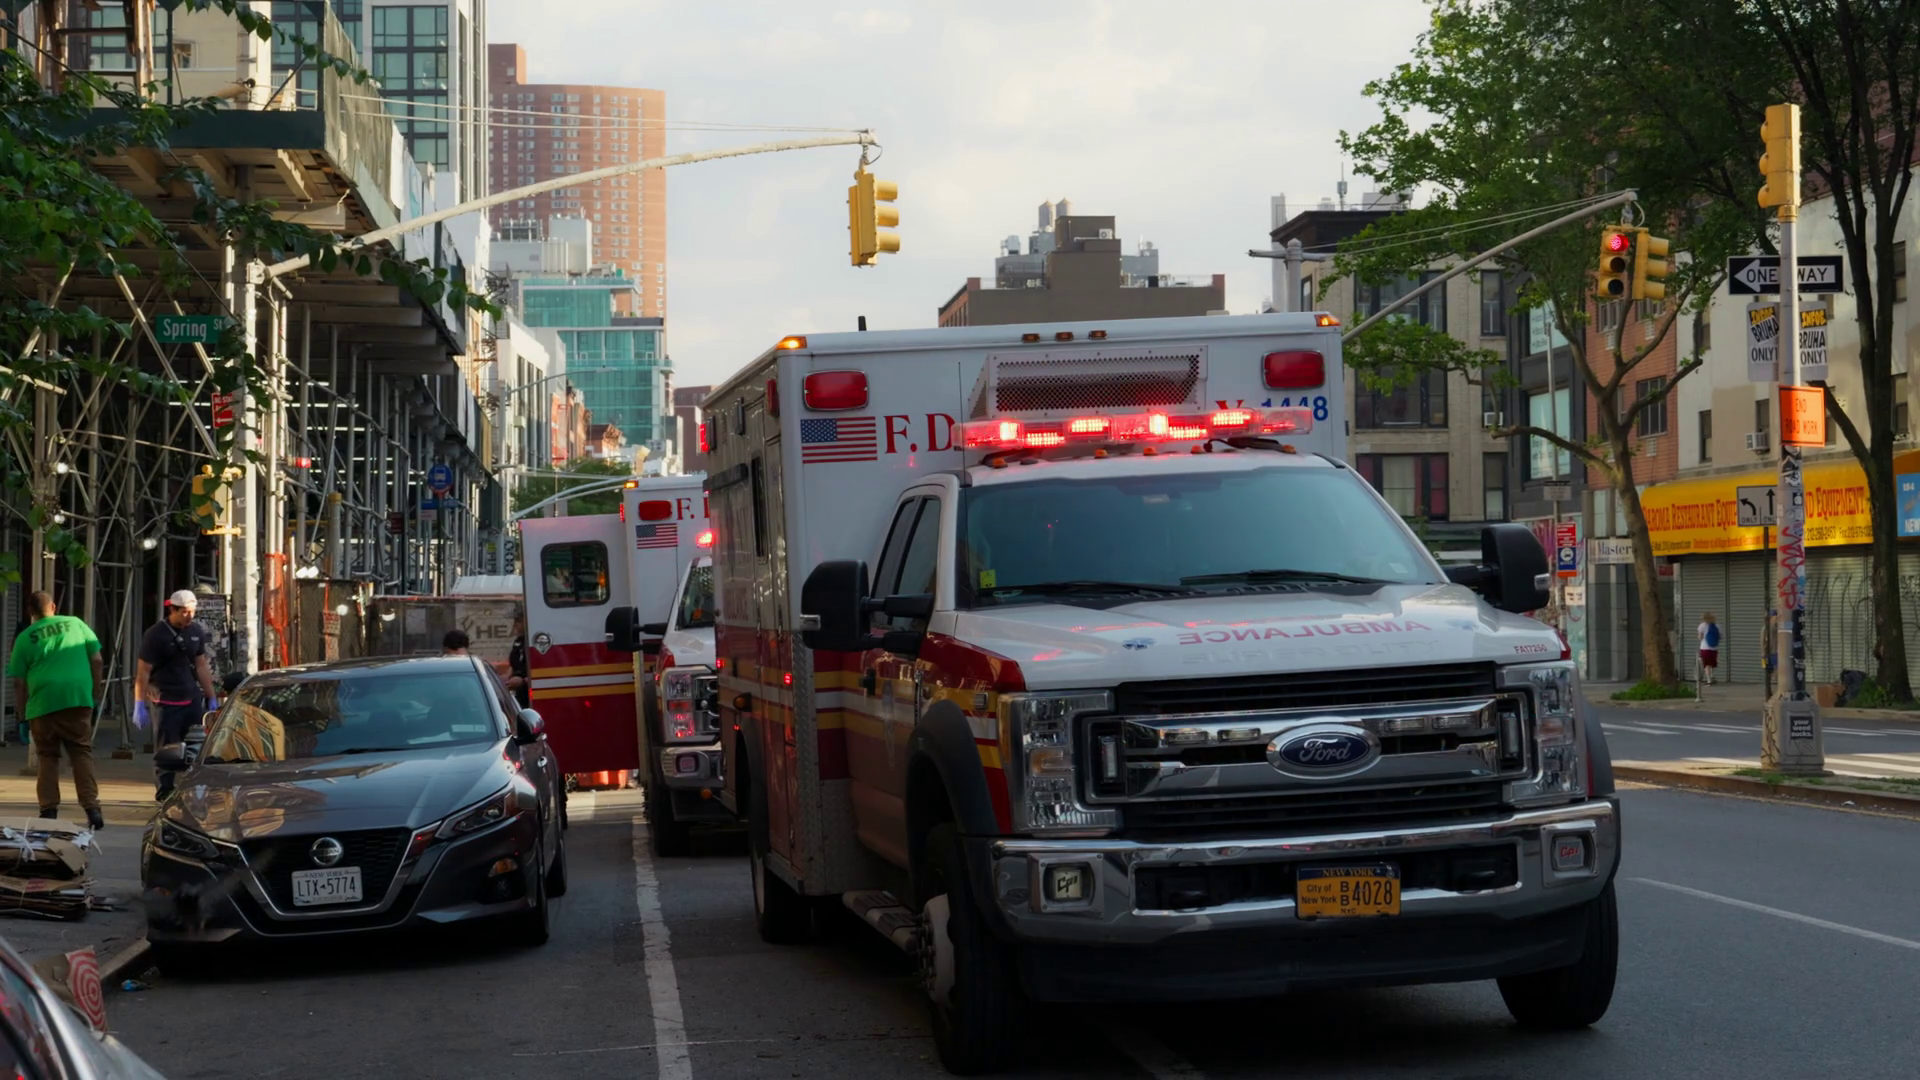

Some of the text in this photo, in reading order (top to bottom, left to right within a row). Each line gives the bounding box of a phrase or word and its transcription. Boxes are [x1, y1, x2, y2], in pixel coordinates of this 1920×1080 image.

[1746, 268, 1778, 283] ONE
[163, 318, 207, 342] Spring
[1751, 317, 1779, 342] BRUHA
[1741, 516, 1758, 524] ONLY
[1763, 515, 1778, 523] ONL
[29, 621, 71, 644] STAFF
[1299, 738, 1351, 762] Ford
[1323, 868, 1375, 878] NEW YORK
[1306, 884, 1332, 894] City of
[1321, 895, 1337, 904] York
